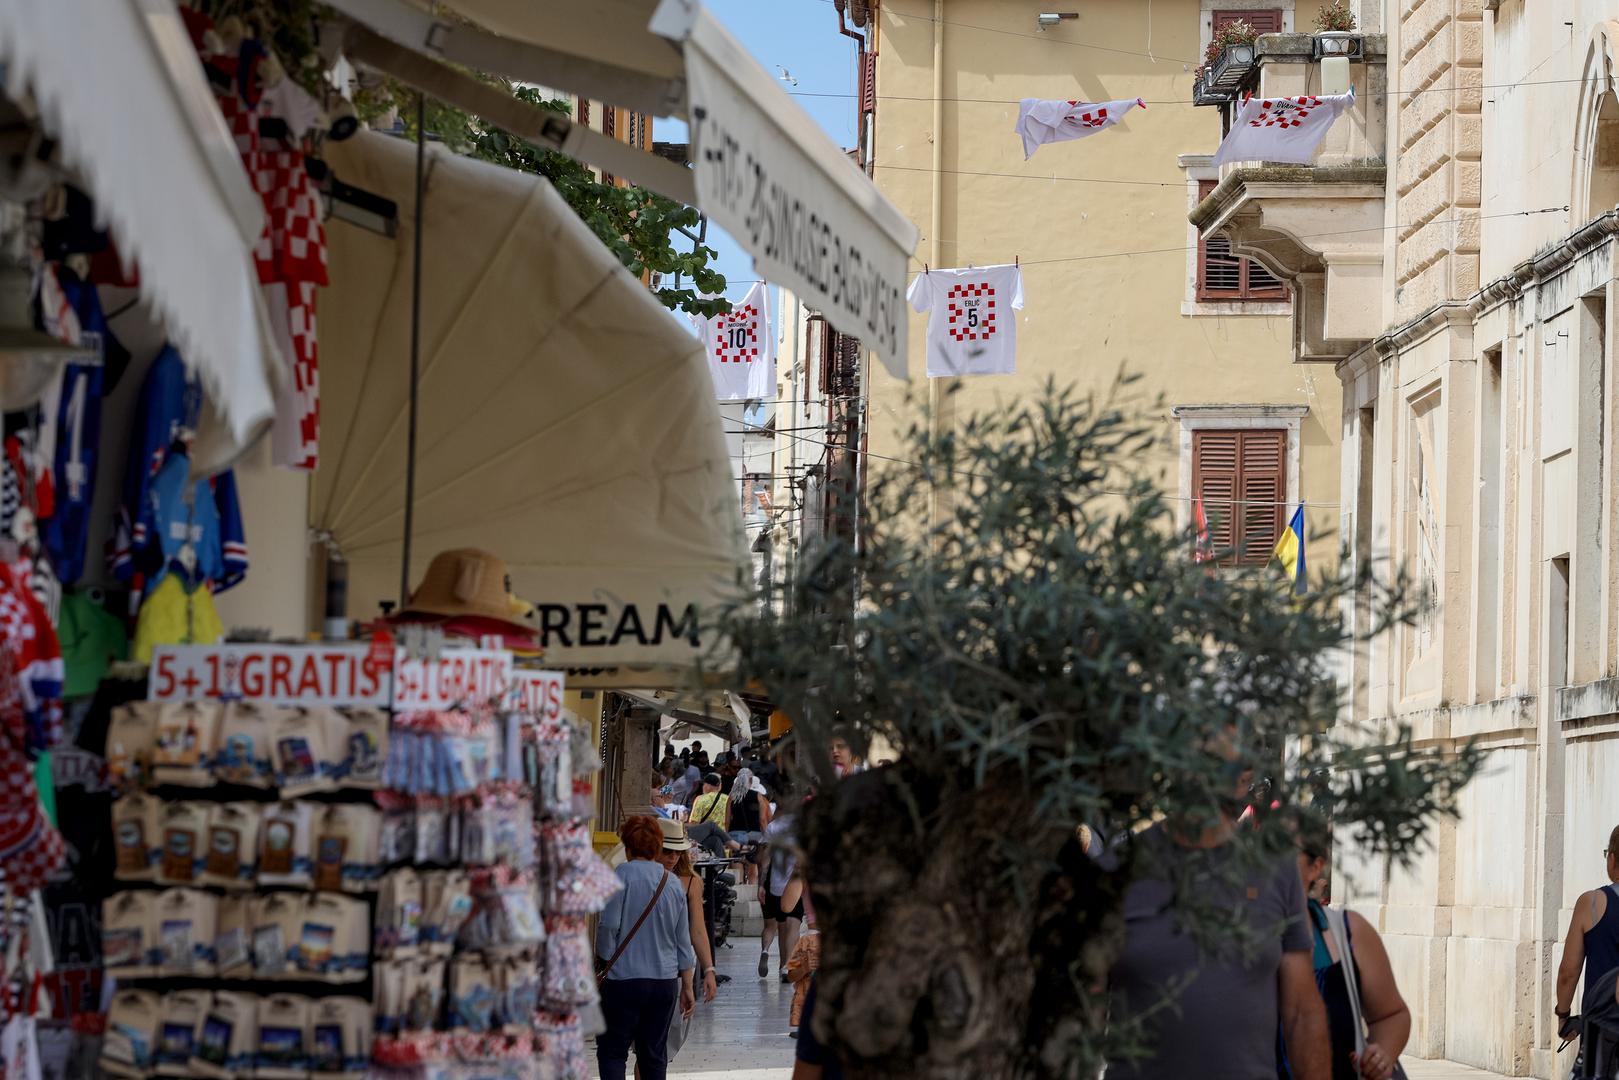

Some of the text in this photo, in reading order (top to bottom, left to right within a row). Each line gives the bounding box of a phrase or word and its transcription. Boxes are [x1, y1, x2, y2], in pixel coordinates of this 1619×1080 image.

[967, 308, 978, 328] 5
[727, 328, 746, 349] 10
[525, 603, 701, 648] REAM
[155, 653, 380, 698] 5+1 GRATIS
